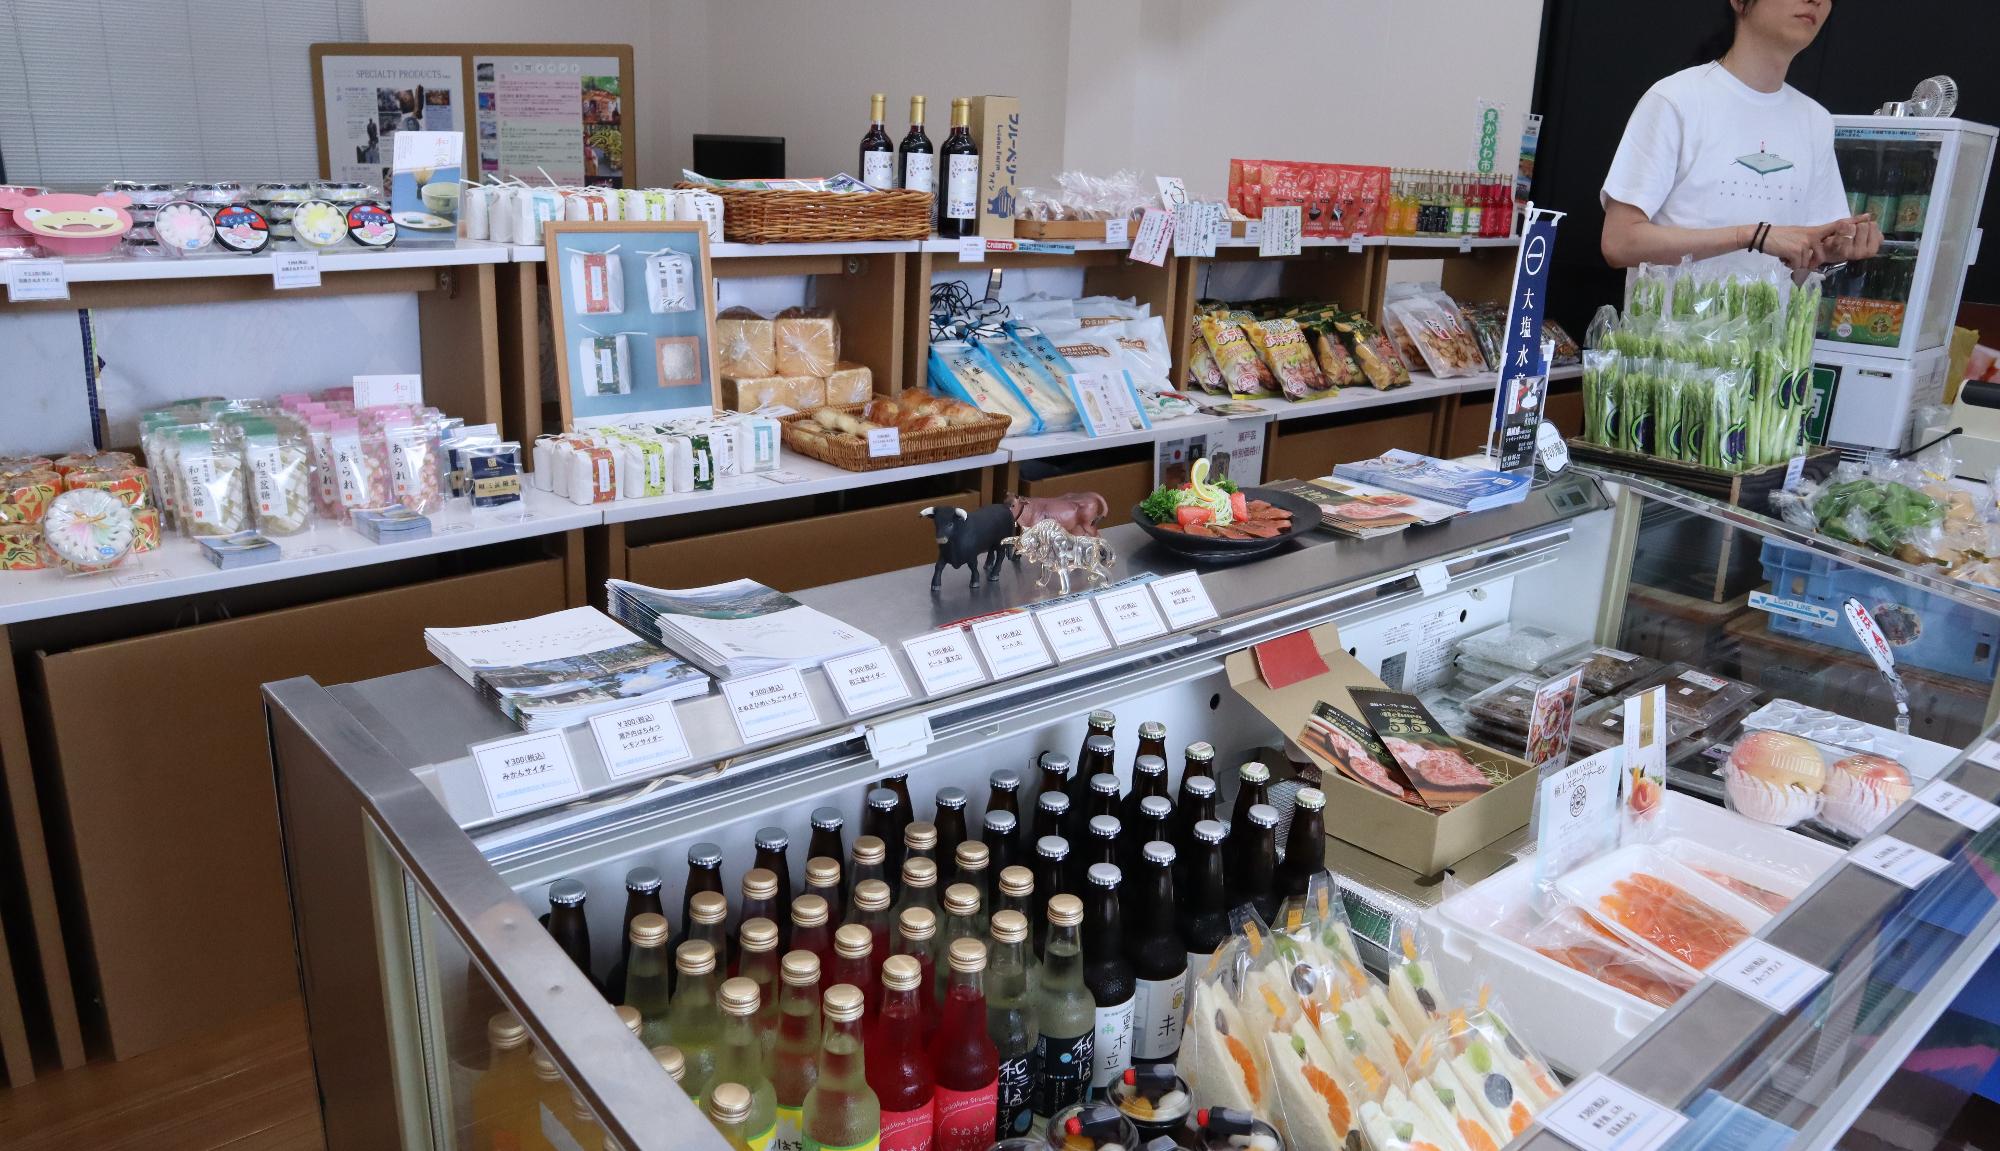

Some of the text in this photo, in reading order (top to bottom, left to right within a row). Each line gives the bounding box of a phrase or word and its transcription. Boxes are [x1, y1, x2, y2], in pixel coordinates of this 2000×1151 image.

[356, 70, 398, 79] SPECIALTY
[400, 70, 441, 79] PRODUCTS
[1481, 111, 1497, 171] 東かがわ市
[392, 443, 405, 480] あられ
[188, 465, 204, 507] 和三盆糖
[255, 460, 271, 500] 和三盆糖
[1774, 597, 1812, 612] LOAD LINE
[618, 724, 662, 741] 瀬戸内はちみつ
[622, 735, 665, 751] レモンサイダー
[502, 764, 554, 781] みかんサイダー
